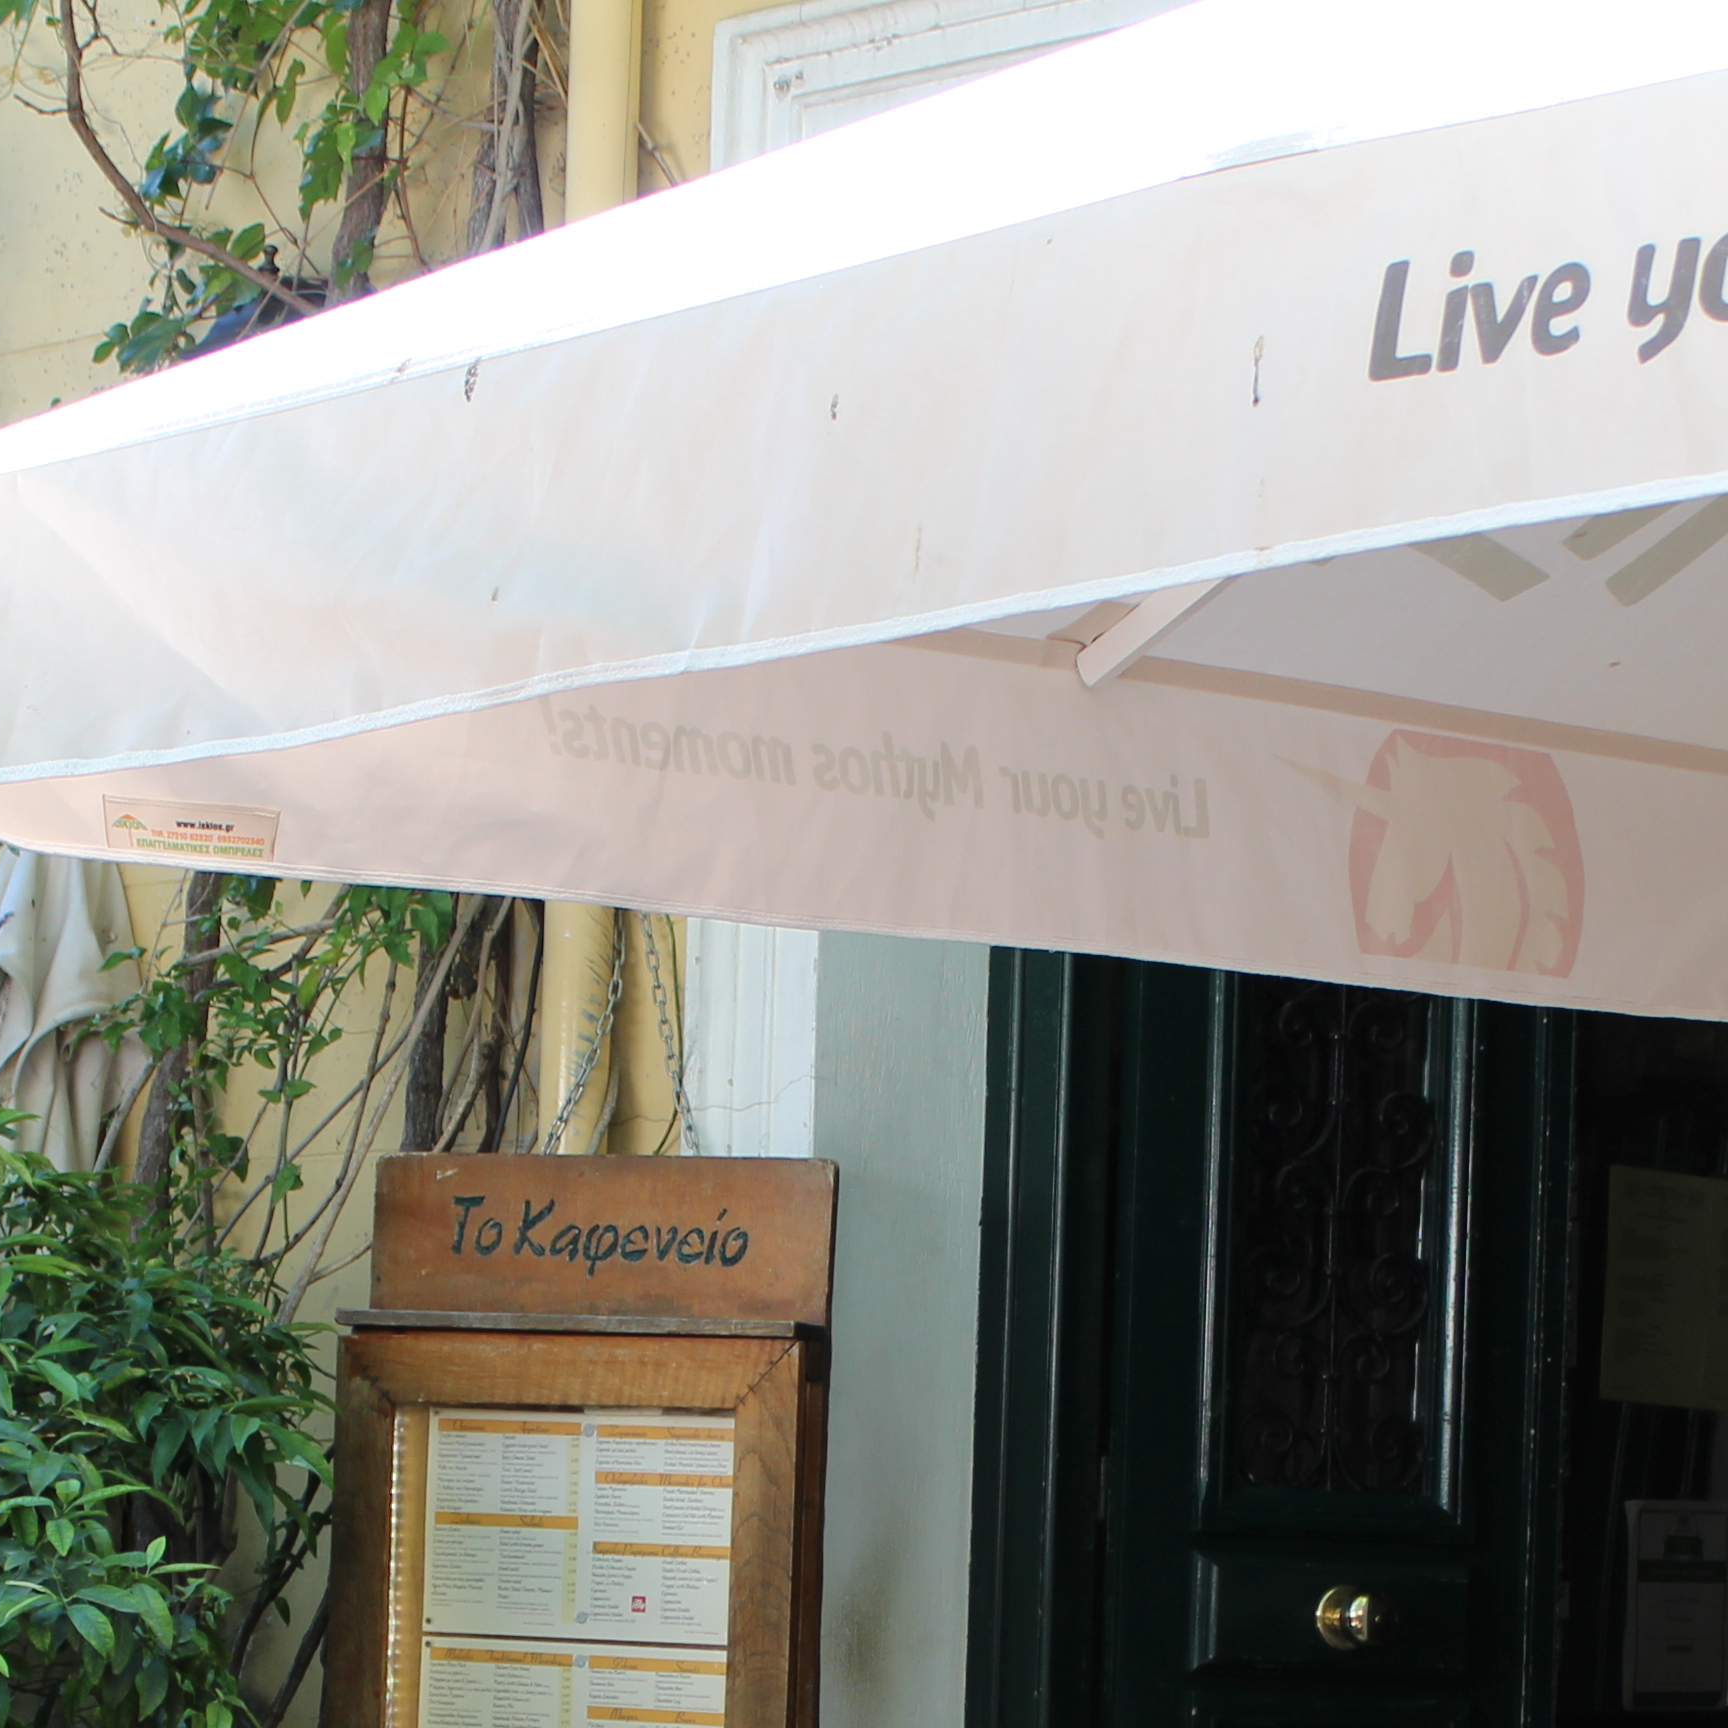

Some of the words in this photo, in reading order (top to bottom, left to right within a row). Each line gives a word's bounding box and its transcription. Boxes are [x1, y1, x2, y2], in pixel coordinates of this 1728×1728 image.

[1368, 250, 1591, 382] Live
[450, 1194, 504, 1257] Το
[512, 1198, 749, 1279] Καφενείο
